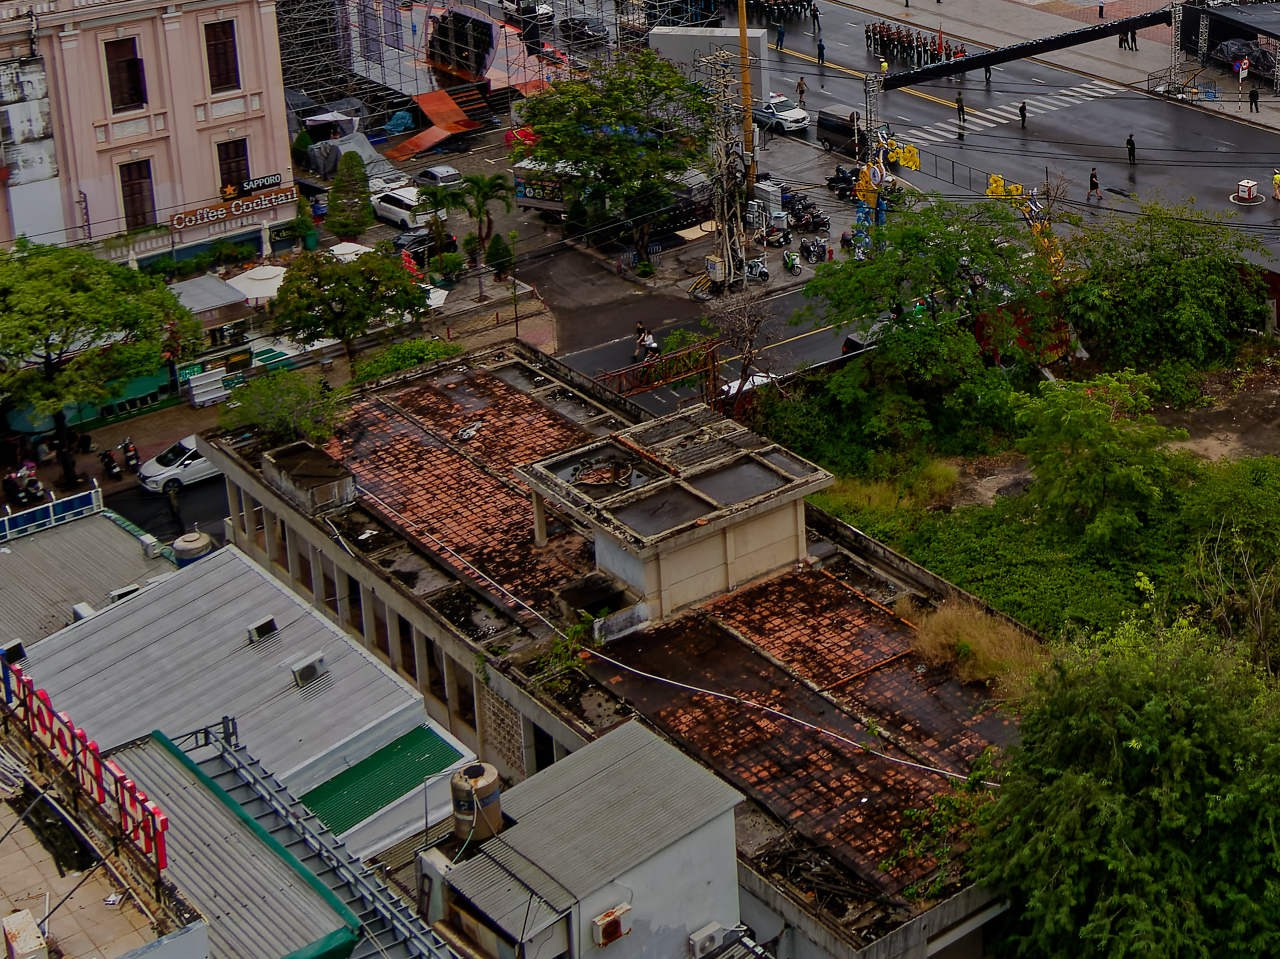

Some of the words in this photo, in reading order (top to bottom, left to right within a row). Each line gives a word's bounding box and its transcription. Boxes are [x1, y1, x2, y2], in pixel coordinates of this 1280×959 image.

[243, 174, 281, 191] SAPPORO
[173, 206, 227, 229] Coffee
[231, 187, 298, 215] Cocktail
